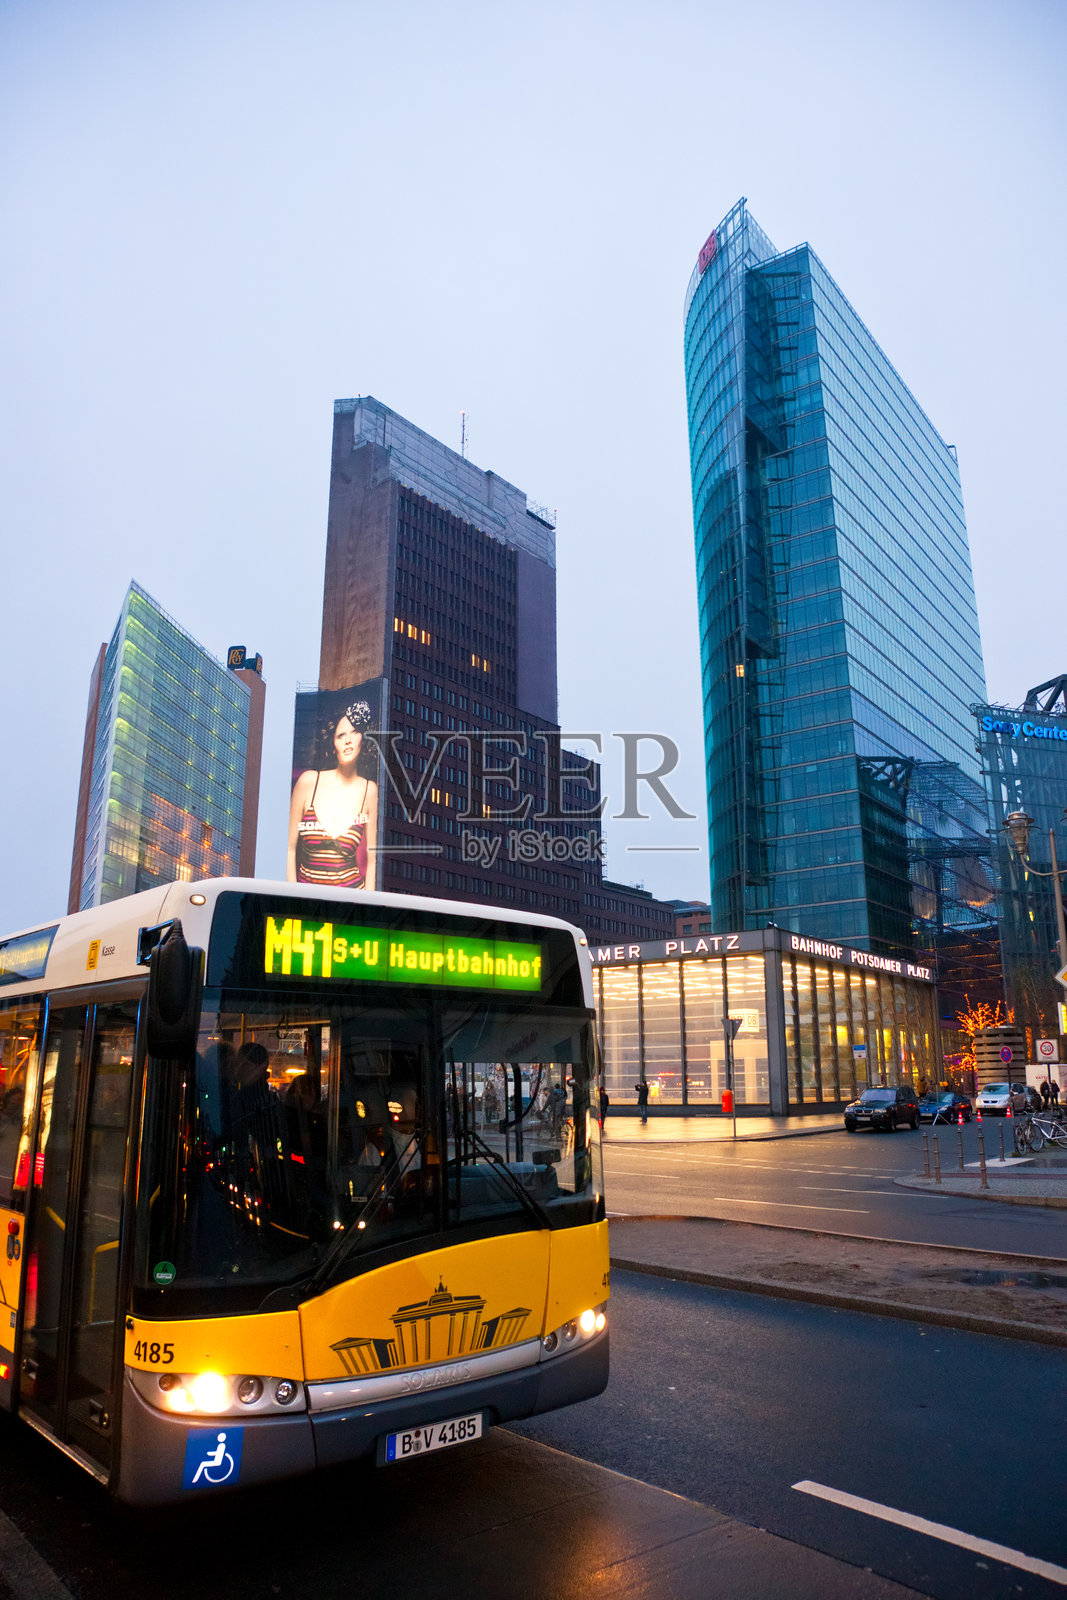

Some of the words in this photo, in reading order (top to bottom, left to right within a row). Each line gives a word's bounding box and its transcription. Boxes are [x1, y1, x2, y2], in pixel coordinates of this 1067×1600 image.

[982, 716, 1021, 738] Sony
[265, 916, 333, 978] M41
[333, 937, 379, 966] S+U
[390, 943, 541, 978] Hauptbahnhof
[665, 935, 740, 956] PLATZ
[791, 935, 843, 960] BAHNHOF
[850, 950, 902, 974] POTSDAMER
[906, 963, 930, 980] PLATZ
[134, 1340, 174, 1364] 4185
[401, 1363, 471, 1393] SOLARIS
[402, 1434, 413, 1454] B
[424, 1427, 434, 1448] V
[438, 1417, 476, 1444] 4185
